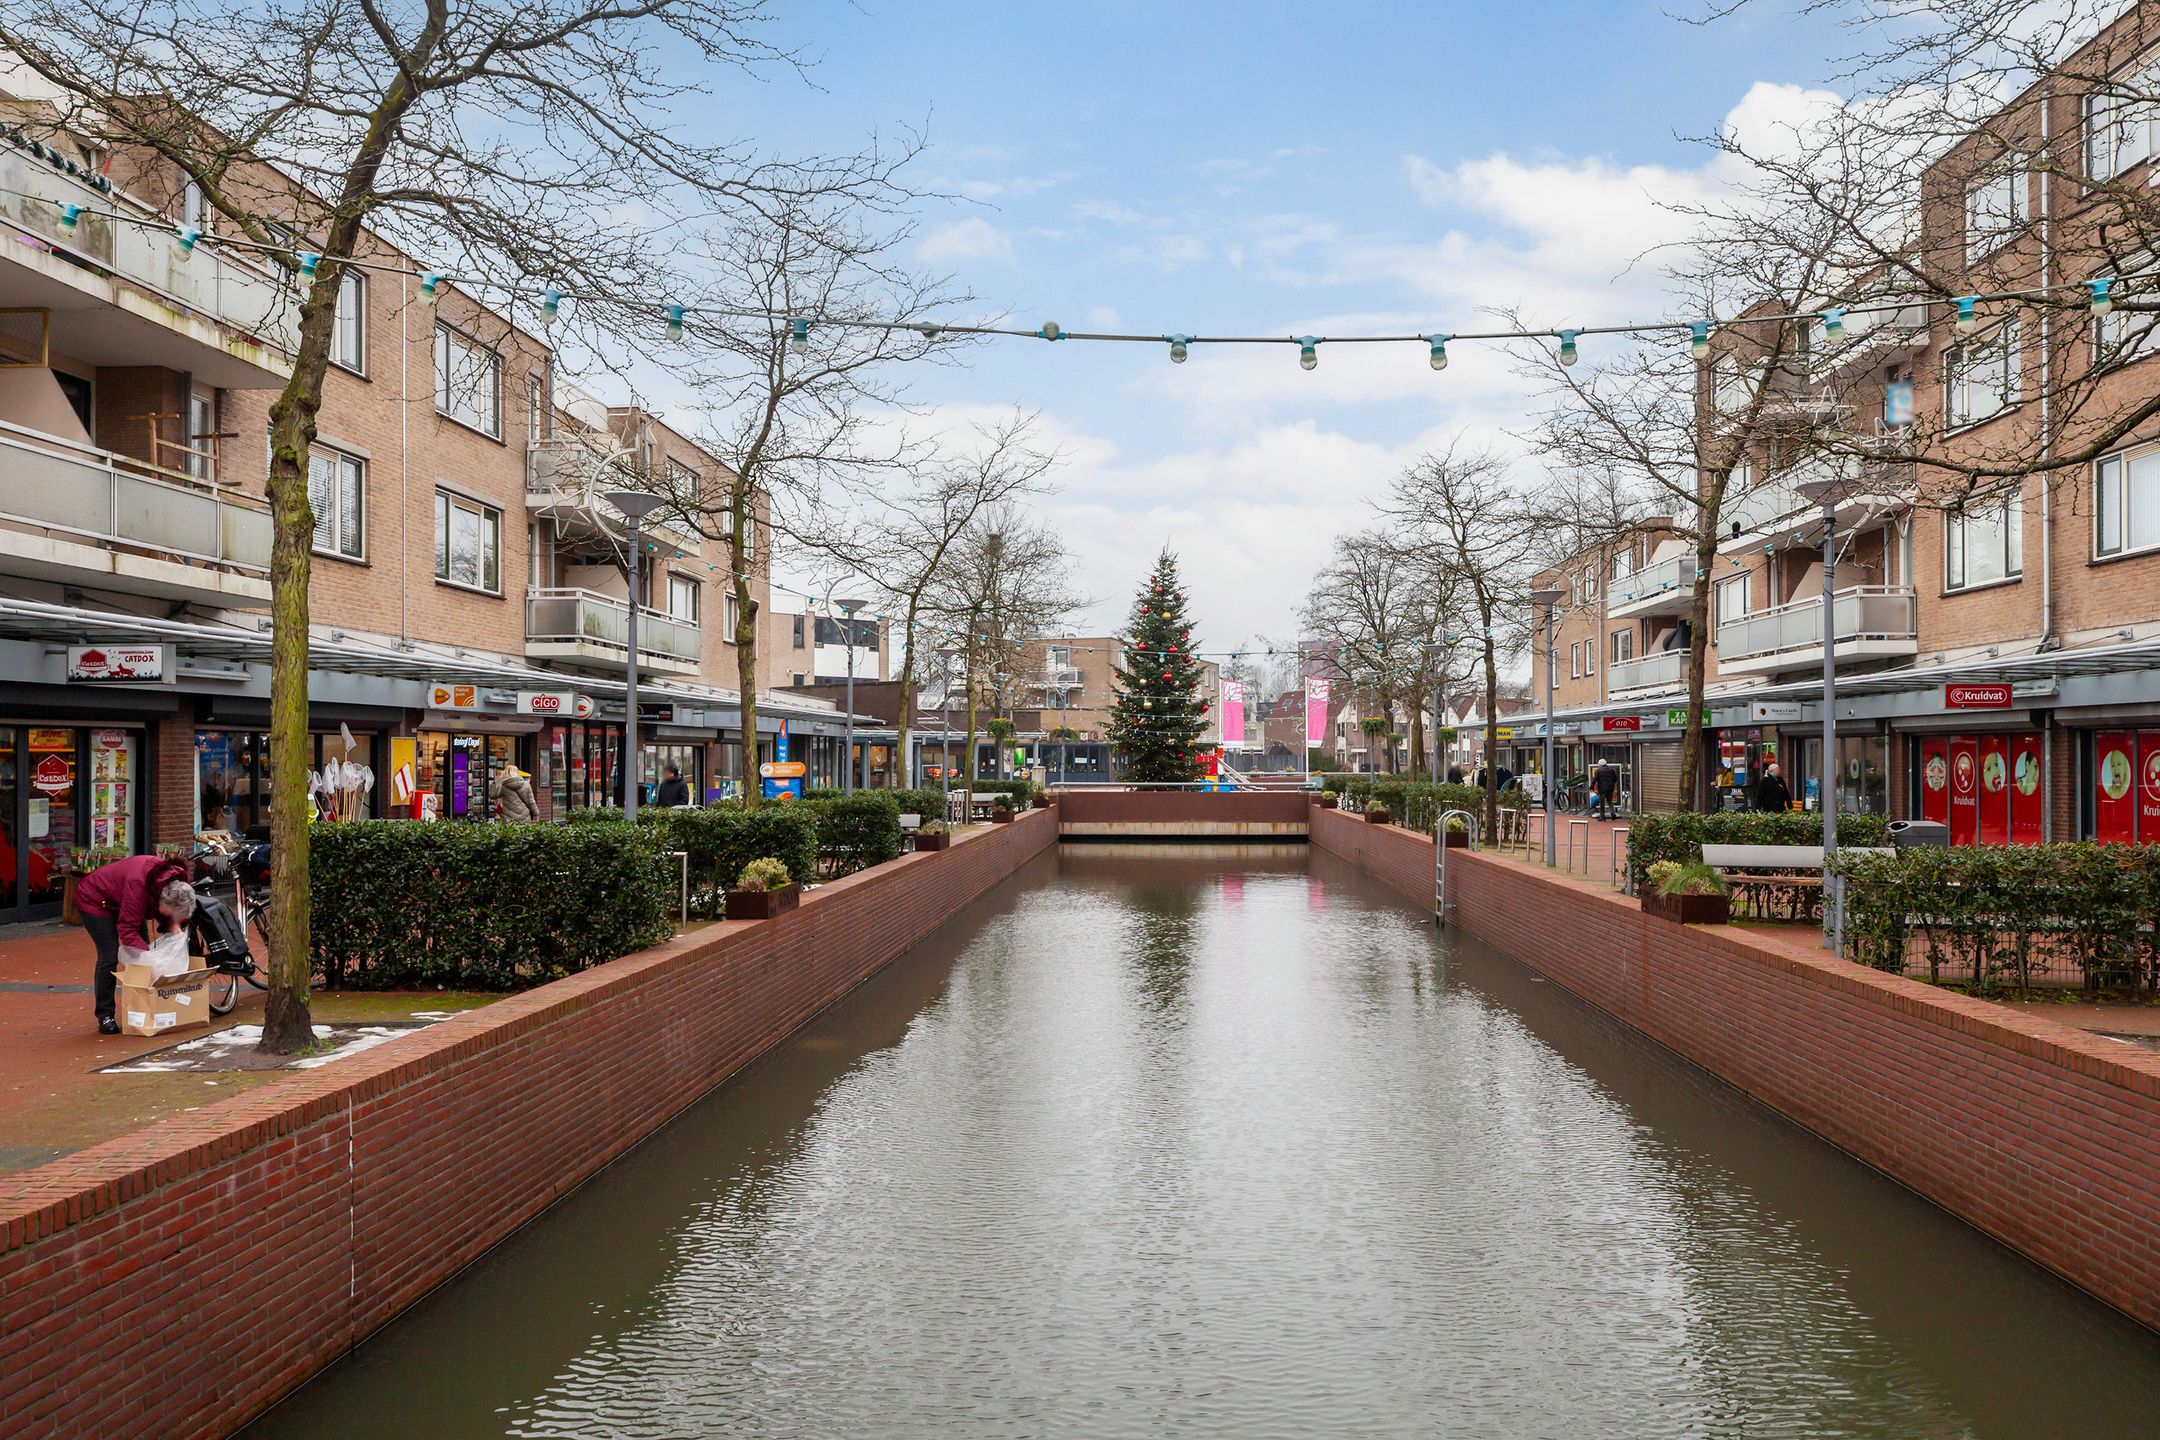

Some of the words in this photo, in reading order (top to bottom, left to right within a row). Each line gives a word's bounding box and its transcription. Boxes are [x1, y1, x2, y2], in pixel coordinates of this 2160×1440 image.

[124, 655, 154, 663] CATDOX
[1964, 690, 2003, 700] Kruidvat
[1953, 795, 1975, 806] Kruidvat
[157, 983, 203, 999] Rummikub
